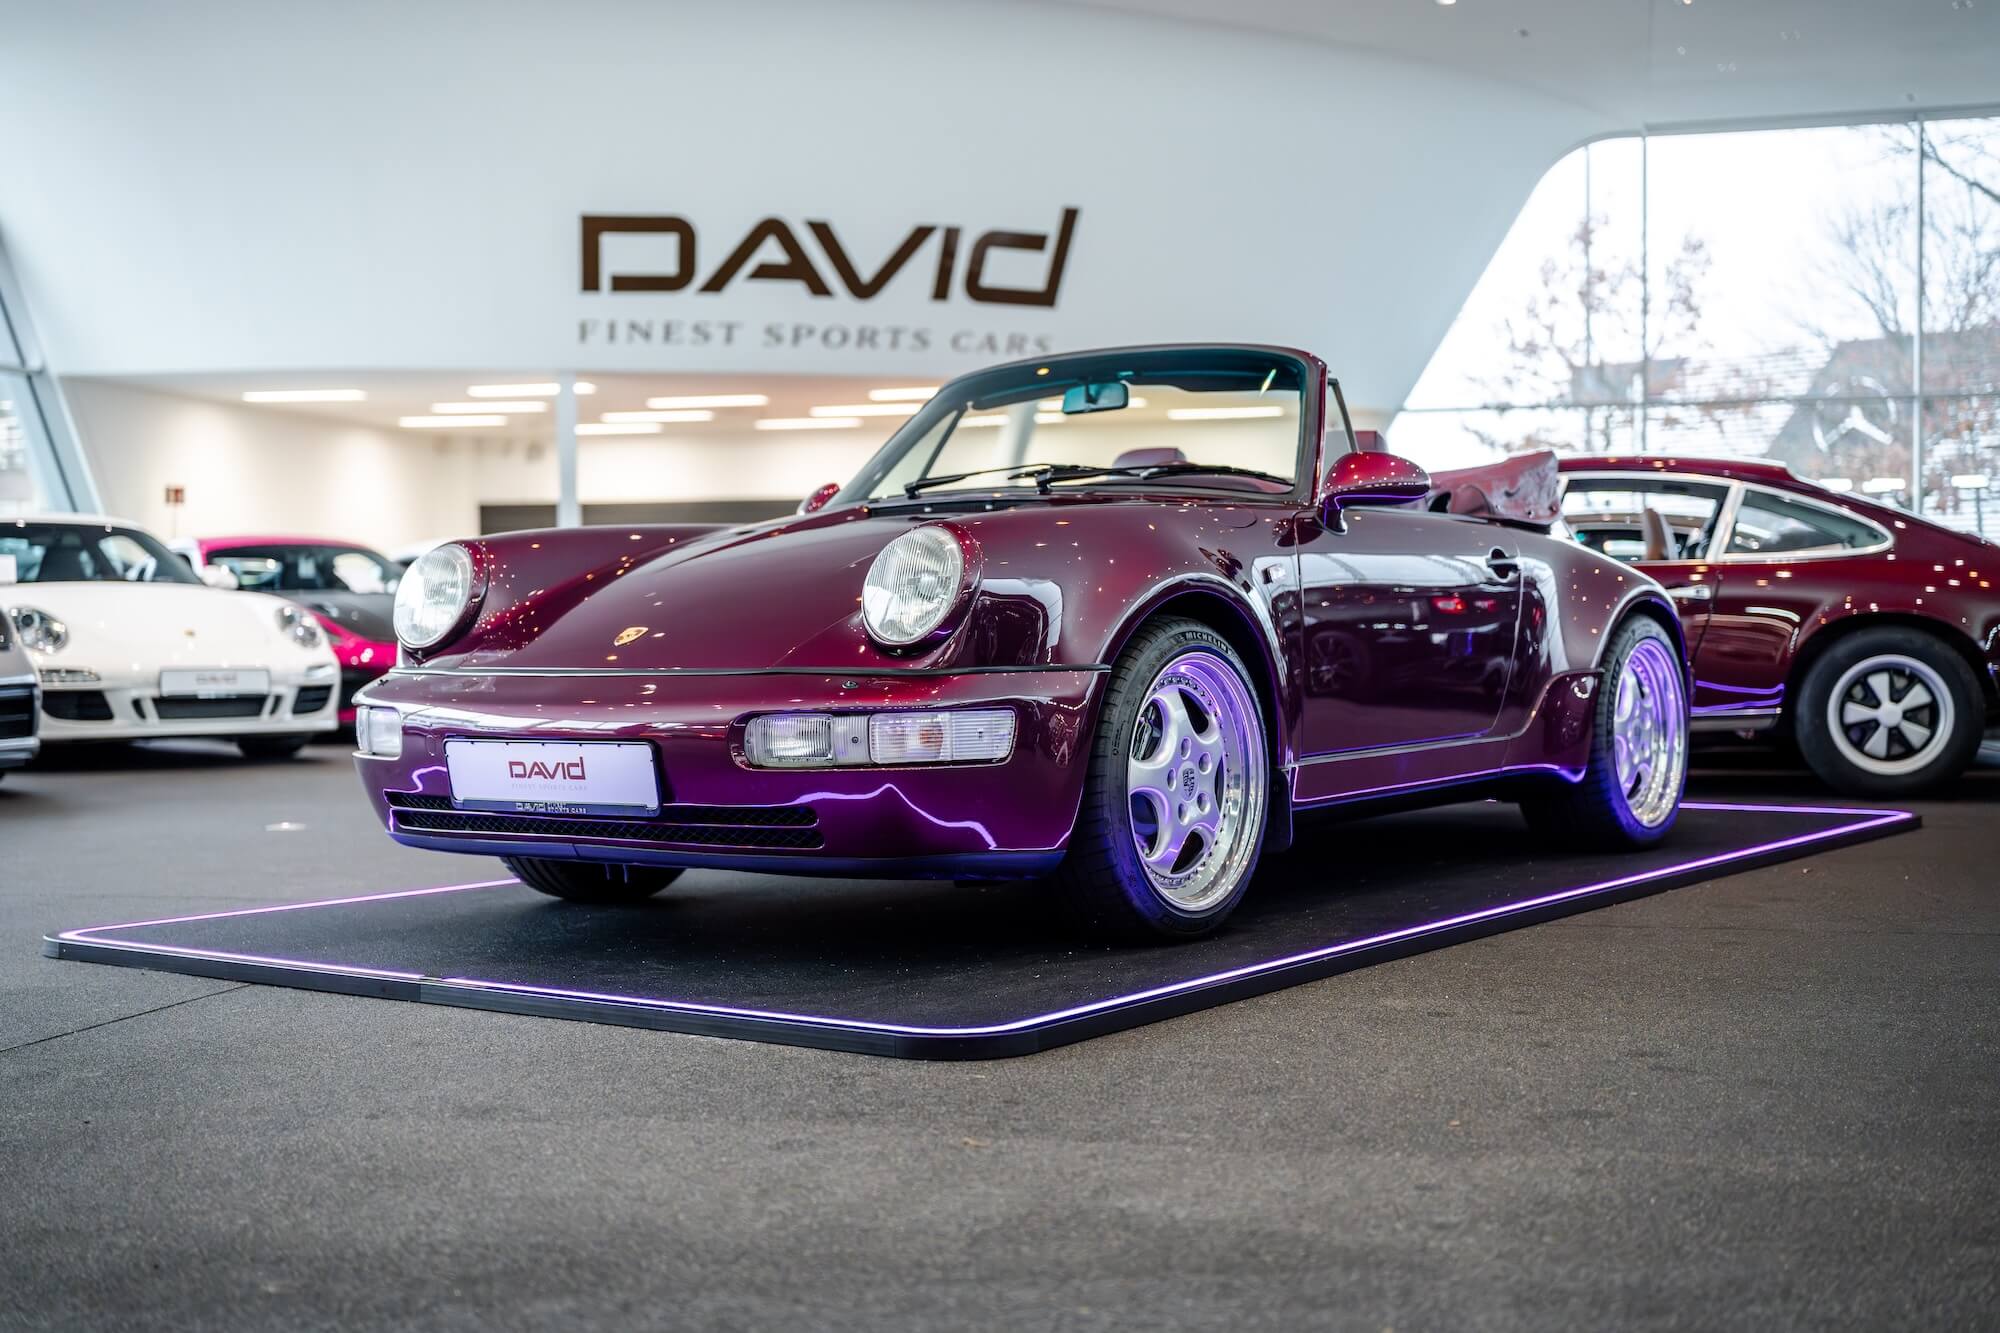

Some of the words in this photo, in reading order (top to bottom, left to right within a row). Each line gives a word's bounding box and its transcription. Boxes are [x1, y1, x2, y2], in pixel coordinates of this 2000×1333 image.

[579, 319, 743, 346] FINEST
[763, 322, 932, 352] SPORTS
[950, 329, 1053, 355] CARS
[1185, 631, 1227, 651] MICHELIN
